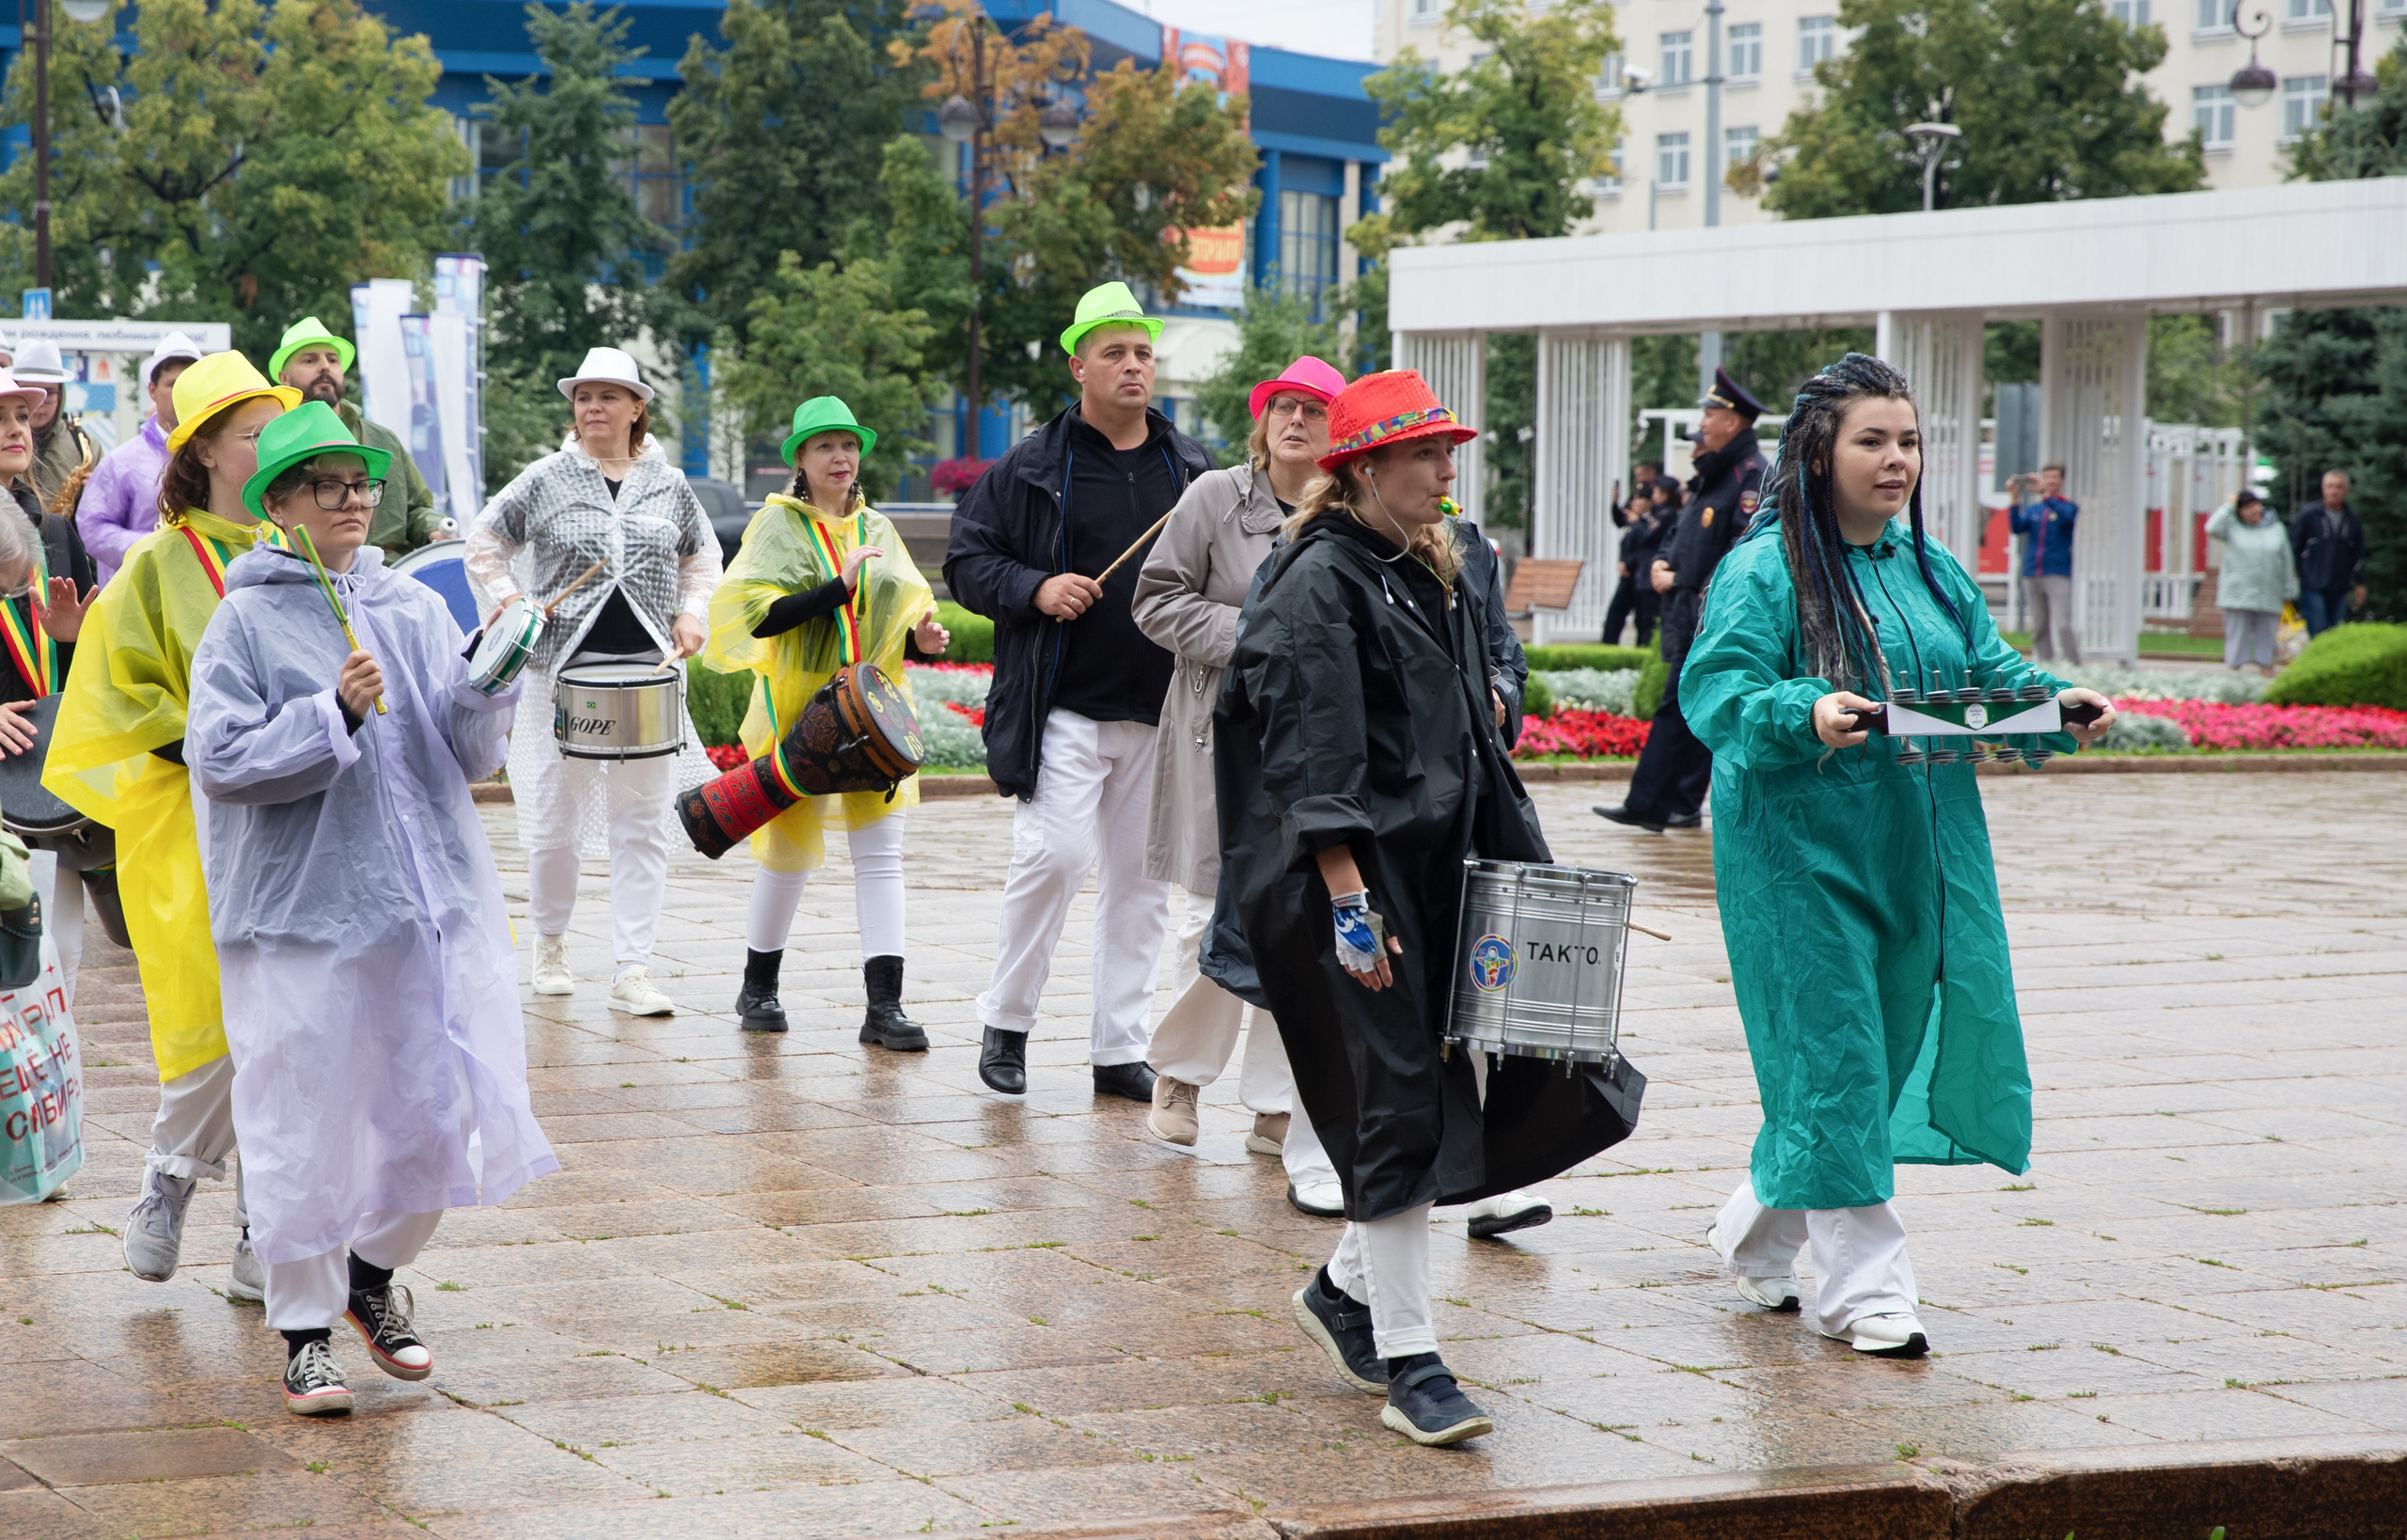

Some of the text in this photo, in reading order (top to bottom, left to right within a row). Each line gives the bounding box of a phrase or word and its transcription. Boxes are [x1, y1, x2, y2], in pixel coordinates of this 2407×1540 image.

[570, 715, 617, 736] GOPE
[49, 1031, 73, 1072] НЕ
[6, 1077, 81, 1141] СИБИРЬ
